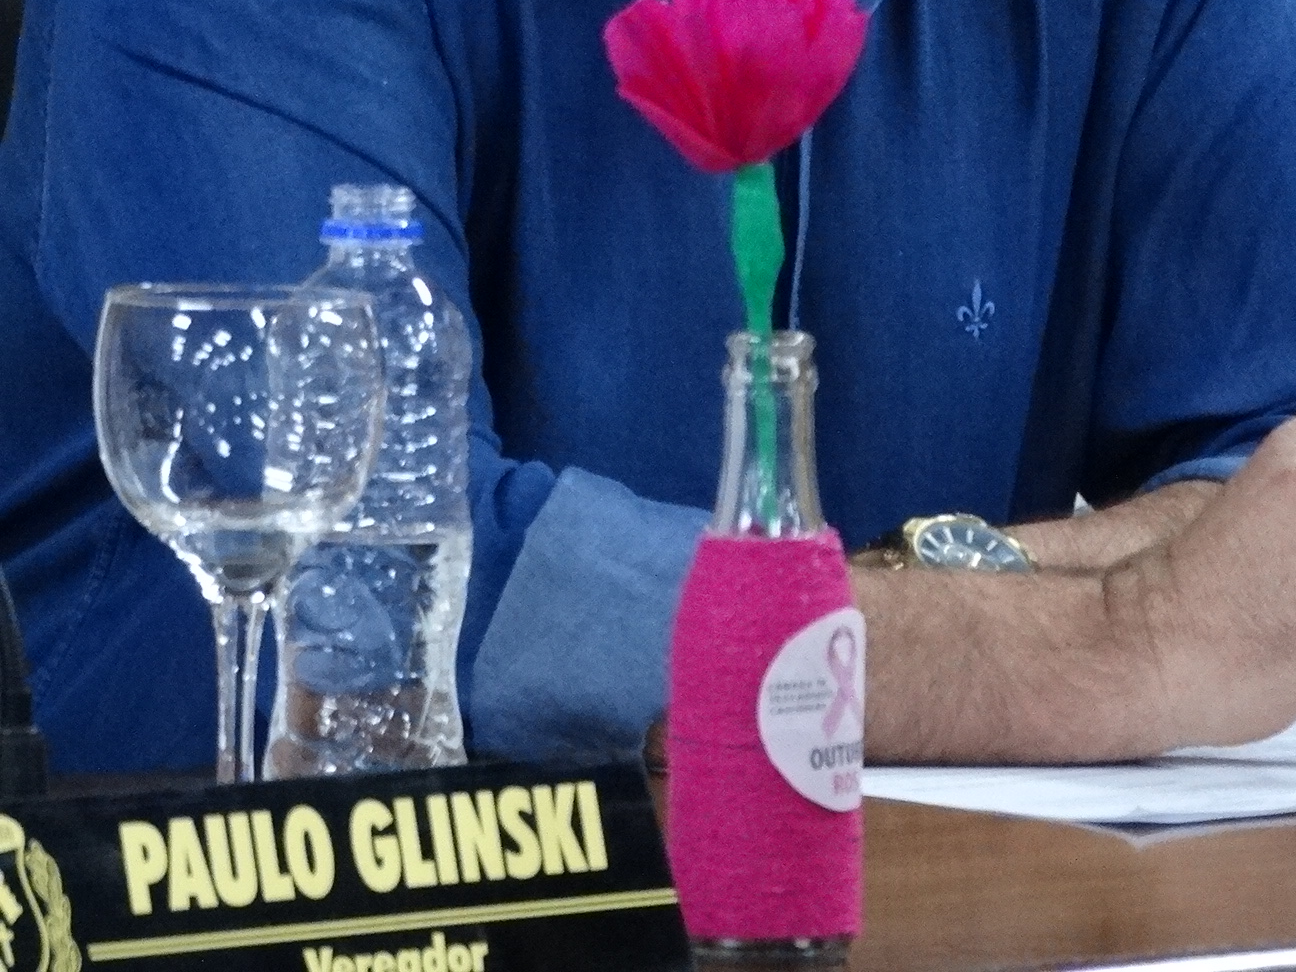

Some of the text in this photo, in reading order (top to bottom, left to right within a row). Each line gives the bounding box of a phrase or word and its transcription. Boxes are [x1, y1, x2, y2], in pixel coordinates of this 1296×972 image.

[117, 780, 609, 916] PAULO GLINSKI
[302, 931, 489, 972] Vereador
